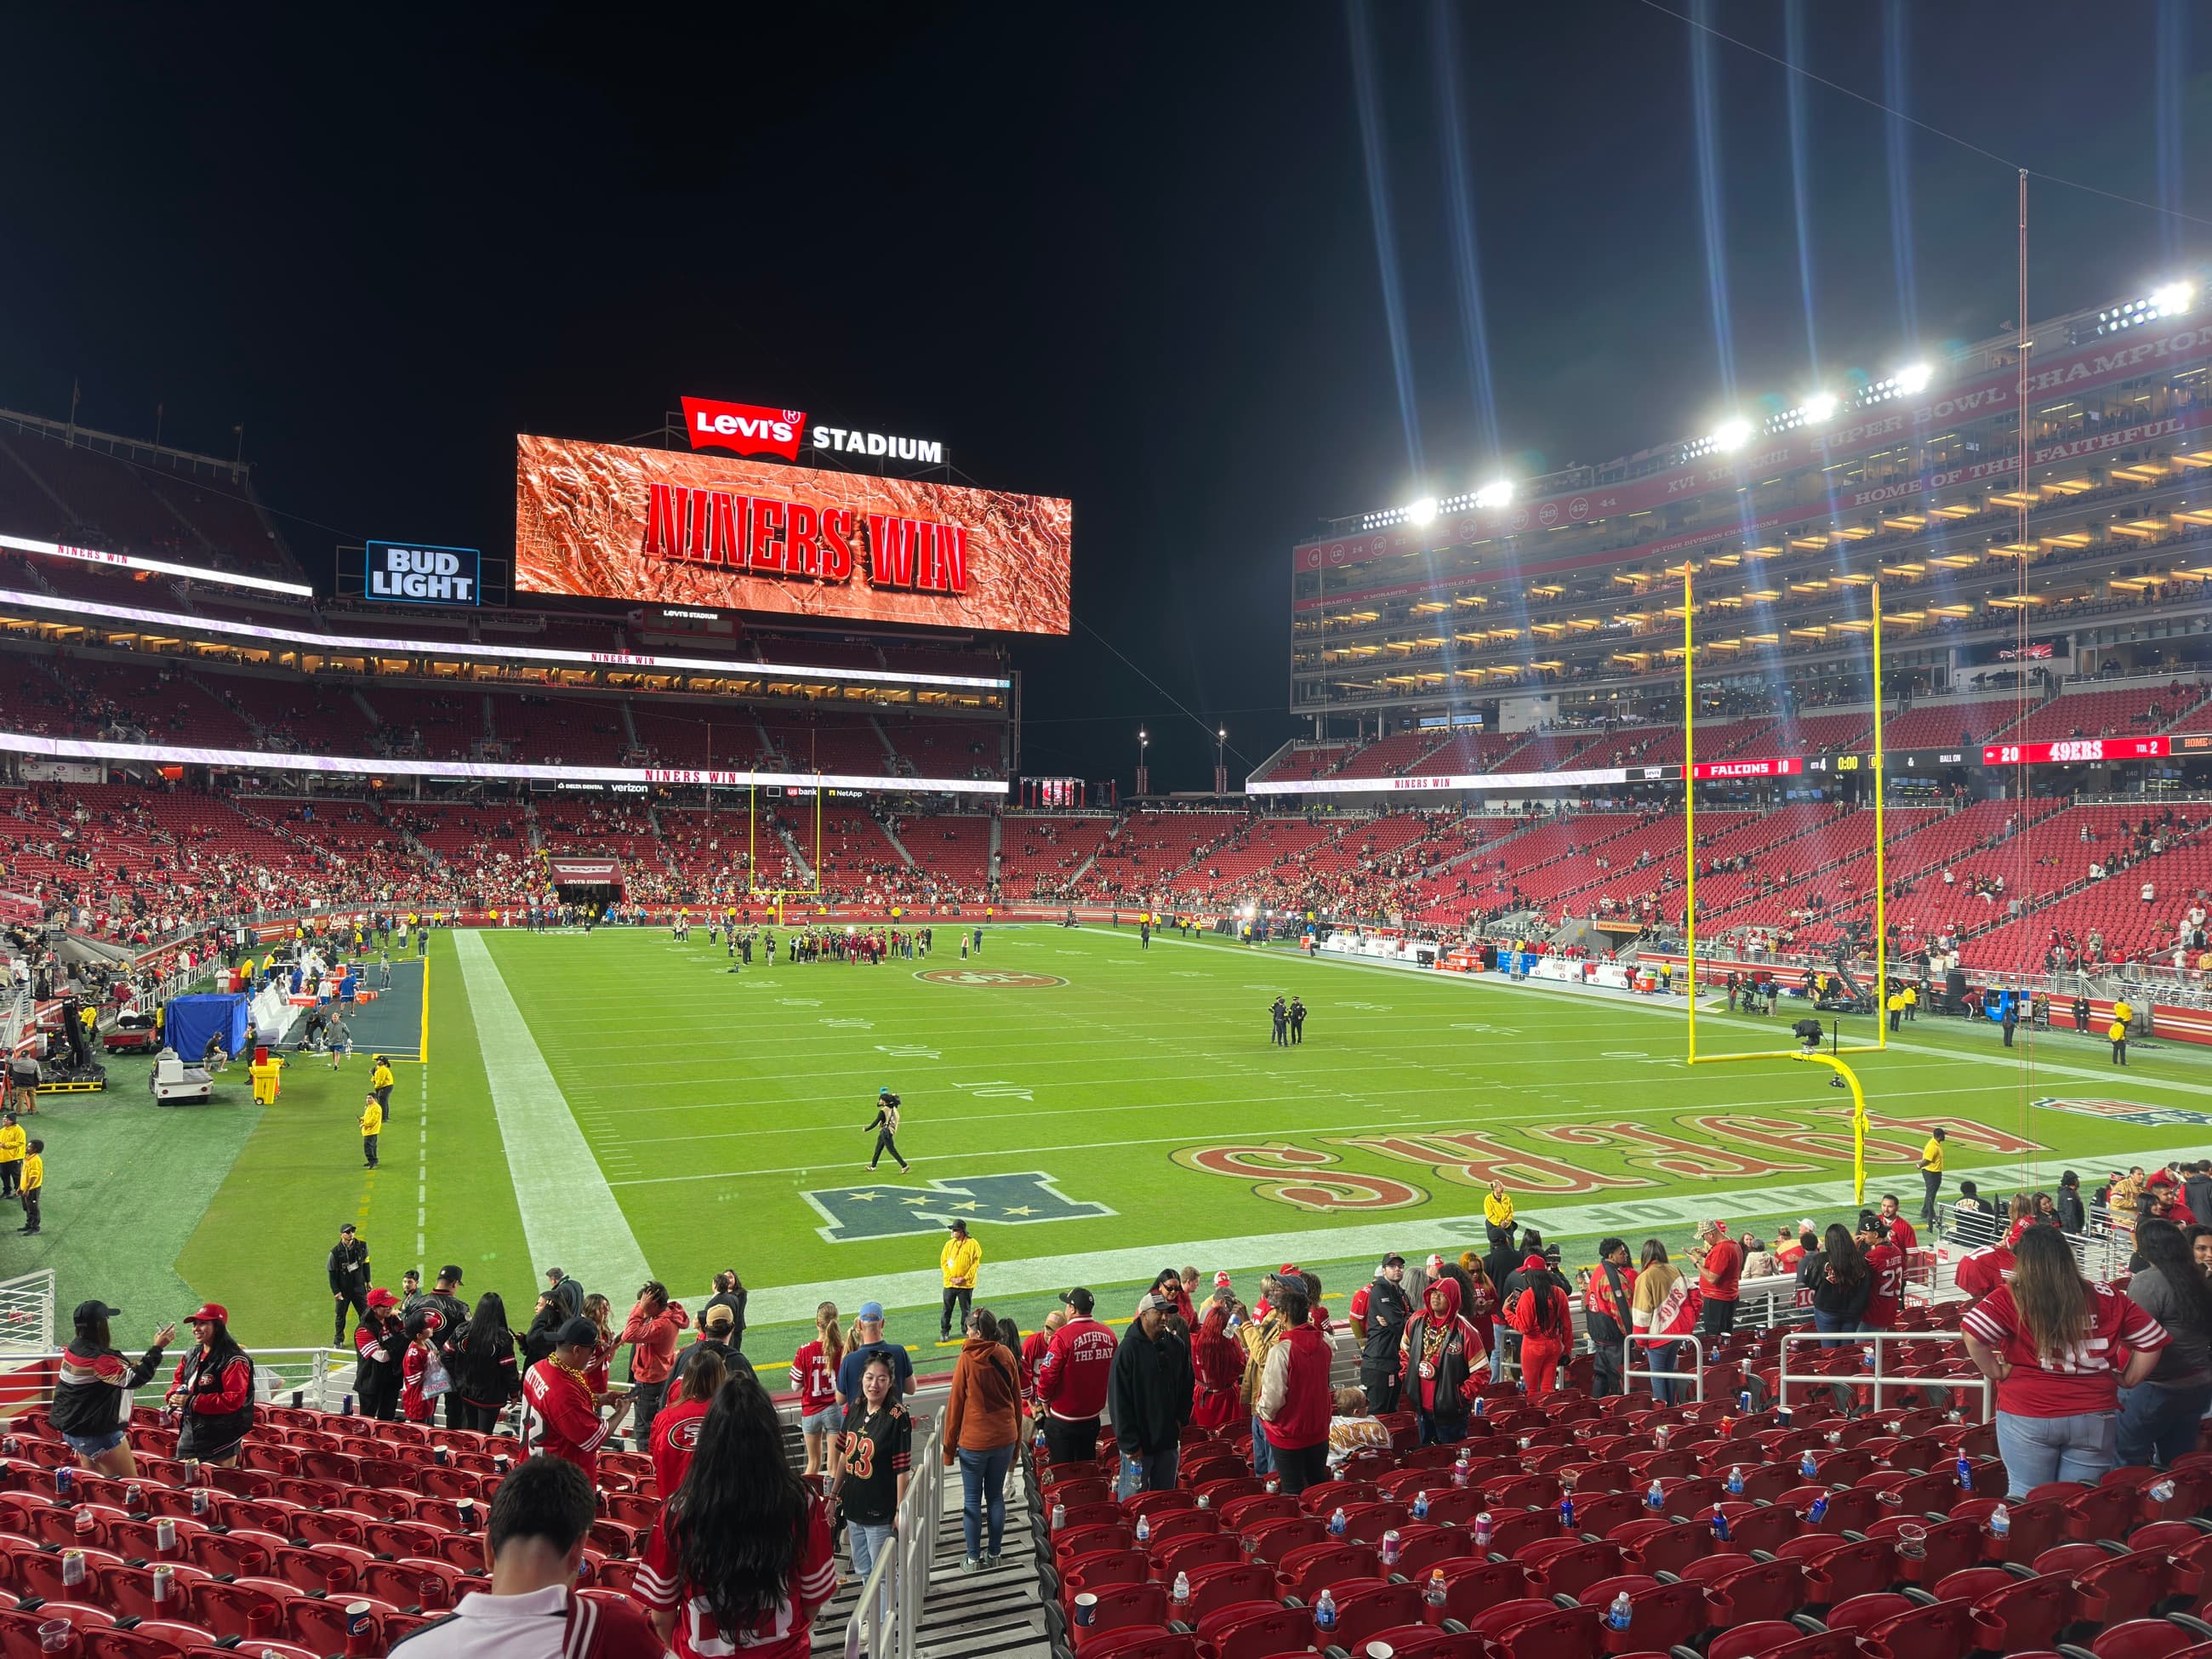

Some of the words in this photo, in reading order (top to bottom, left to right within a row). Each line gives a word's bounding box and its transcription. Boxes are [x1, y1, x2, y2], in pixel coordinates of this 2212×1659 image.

[1810, 415, 1904, 453] SUPER
[1913, 388, 2006, 425] BOWL
[812, 425, 942, 463] STADIUM
[1855, 479, 1922, 506] HOME
[1930, 470, 1962, 487] OF
[1970, 456, 2020, 480] THE
[2034, 419, 2186, 464] FAITHFUL
[1668, 476, 1696, 493] XVI
[644, 482, 852, 579] NINERS
[868, 514, 969, 595] WIN
[1685, 533, 1723, 546] DIVISION
[1725, 519, 1778, 537] CHAMPIONS
[58, 544, 100, 560] NINERS
[107, 552, 128, 563] WIN
[387, 547, 459, 574] BUD
[591, 652, 630, 664] NINERS
[635, 656, 654, 665] WIN
[2001, 746, 2018, 761] 20
[2050, 739, 2102, 761] 49ERS
[2150, 741, 2158, 755] 2
[2185, 738, 2208, 747] HOME
[1694, 767, 1699, 777] 0
[1710, 762, 1769, 776] FALCONS
[1777, 759, 1789, 773] 10
[1820, 758, 1827, 771] 4
[1838, 755, 1858, 770] 0:00
[1871, 756, 1876, 767] 0
[1953, 754, 1961, 762] ON
[646, 770, 701, 784] NINERS
[709, 772, 737, 784] WIN
[1394, 778, 1428, 789] NINERS
[1433, 778, 1451, 788] WIN
[611, 783, 648, 793] verizon
[798, 788, 817, 796] bank
[836, 790, 862, 799] NetApp
[1171, 1108, 2052, 1214] 49ERS
[1694, 1183, 1838, 1219] ALL
[1583, 1203, 1686, 1226] OF
[1878, 1267, 1903, 1297] 23
[1658, 1287, 1685, 1325] 49ERS
[1074, 1331, 1114, 1351] FAITHFUL
[812, 1356, 830, 1365] PUR
[1074, 1350, 1093, 1363] THE
[1096, 1348, 1114, 1360] BAY
[523, 1365, 550, 1401] ATTERS
[812, 1369, 837, 1398] 13
[845, 1431, 875, 1480] 23
